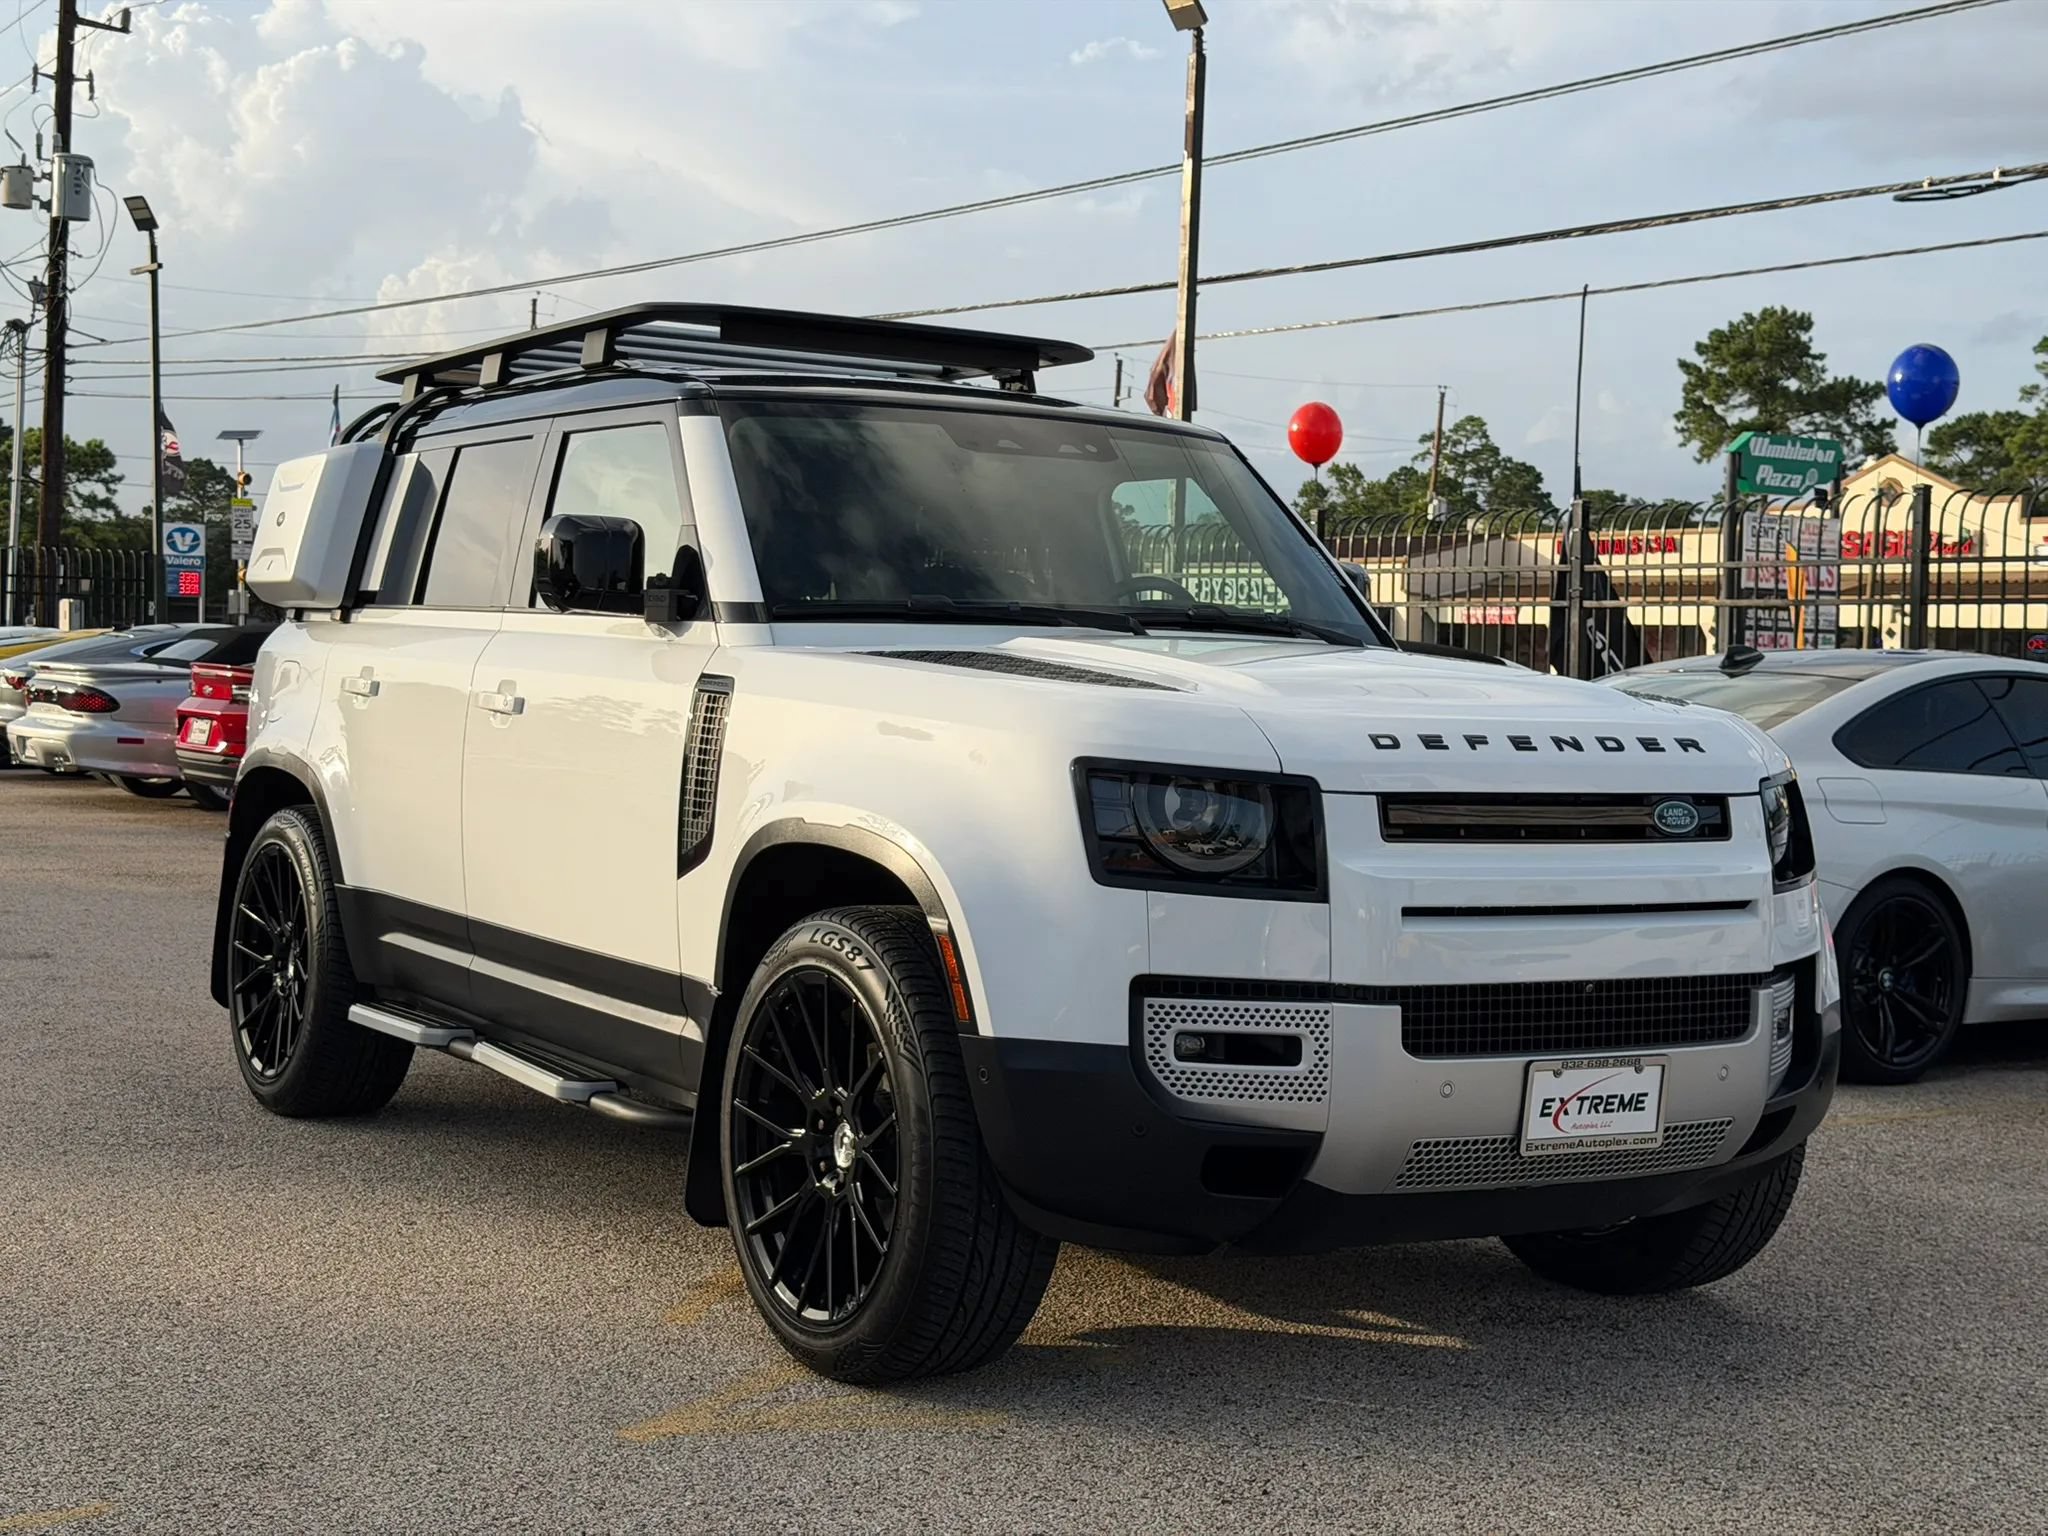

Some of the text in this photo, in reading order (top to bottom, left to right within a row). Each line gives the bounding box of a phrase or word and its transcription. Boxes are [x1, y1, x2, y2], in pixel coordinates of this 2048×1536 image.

[1749, 436, 1837, 462] Wimbledon
[1755, 465, 1804, 489] Plaza
[233, 518, 252, 529] 25
[166, 556, 202, 567] Valero
[1367, 733, 1707, 754] DEFENDER
[1664, 808, 1684, 817] LAND
[1667, 817, 1691, 825] ROVER
[808, 927, 877, 971] LGS87
[1539, 1092, 1649, 1118] EXTREME
[1525, 1136, 1658, 1153] ExtremeAutoplex.com
